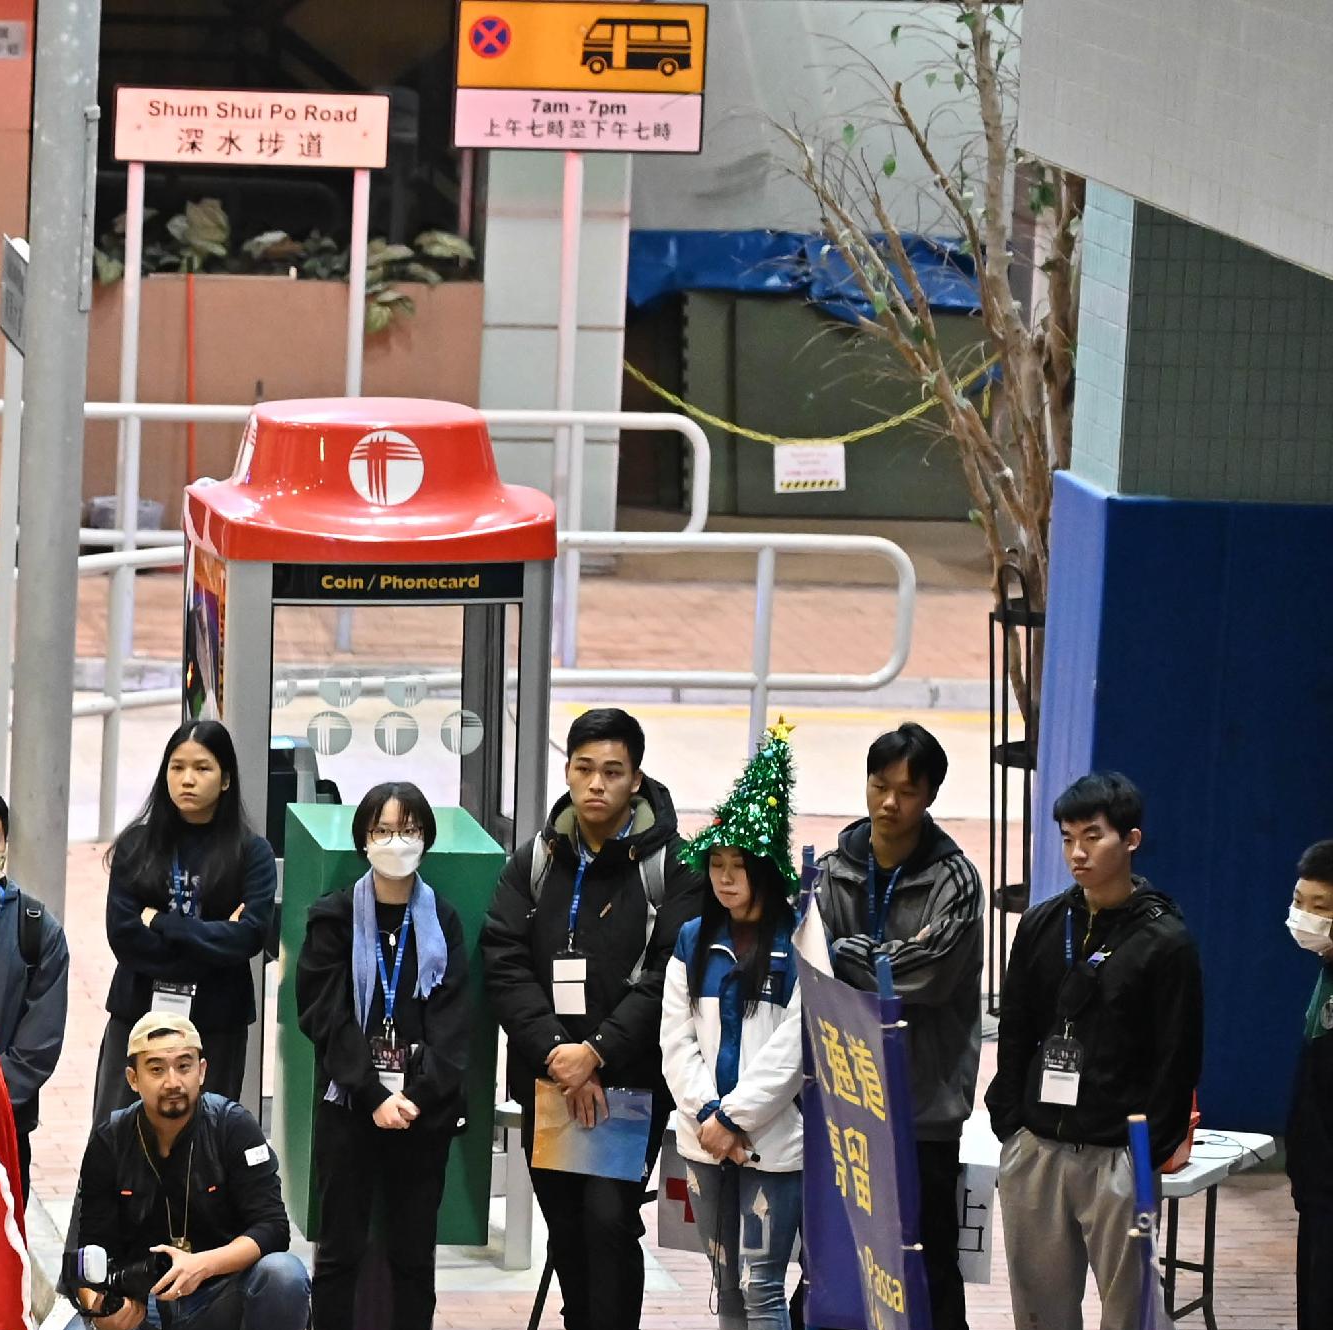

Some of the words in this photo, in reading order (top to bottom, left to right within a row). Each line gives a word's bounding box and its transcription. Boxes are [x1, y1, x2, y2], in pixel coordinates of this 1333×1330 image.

[149, 100, 208, 117] Shum
[216, 102, 262, 119] Shui
[271, 104, 296, 120] Po
[305, 105, 357, 122] Road
[532, 99, 569, 114] 7am
[588, 100, 626, 116] 7pm
[484, 118, 671, 141] 上午七時至下午七時
[178, 128, 324, 158] 深水埗道
[321, 574, 364, 590] Coin
[380, 574, 480, 590] Phonecard
